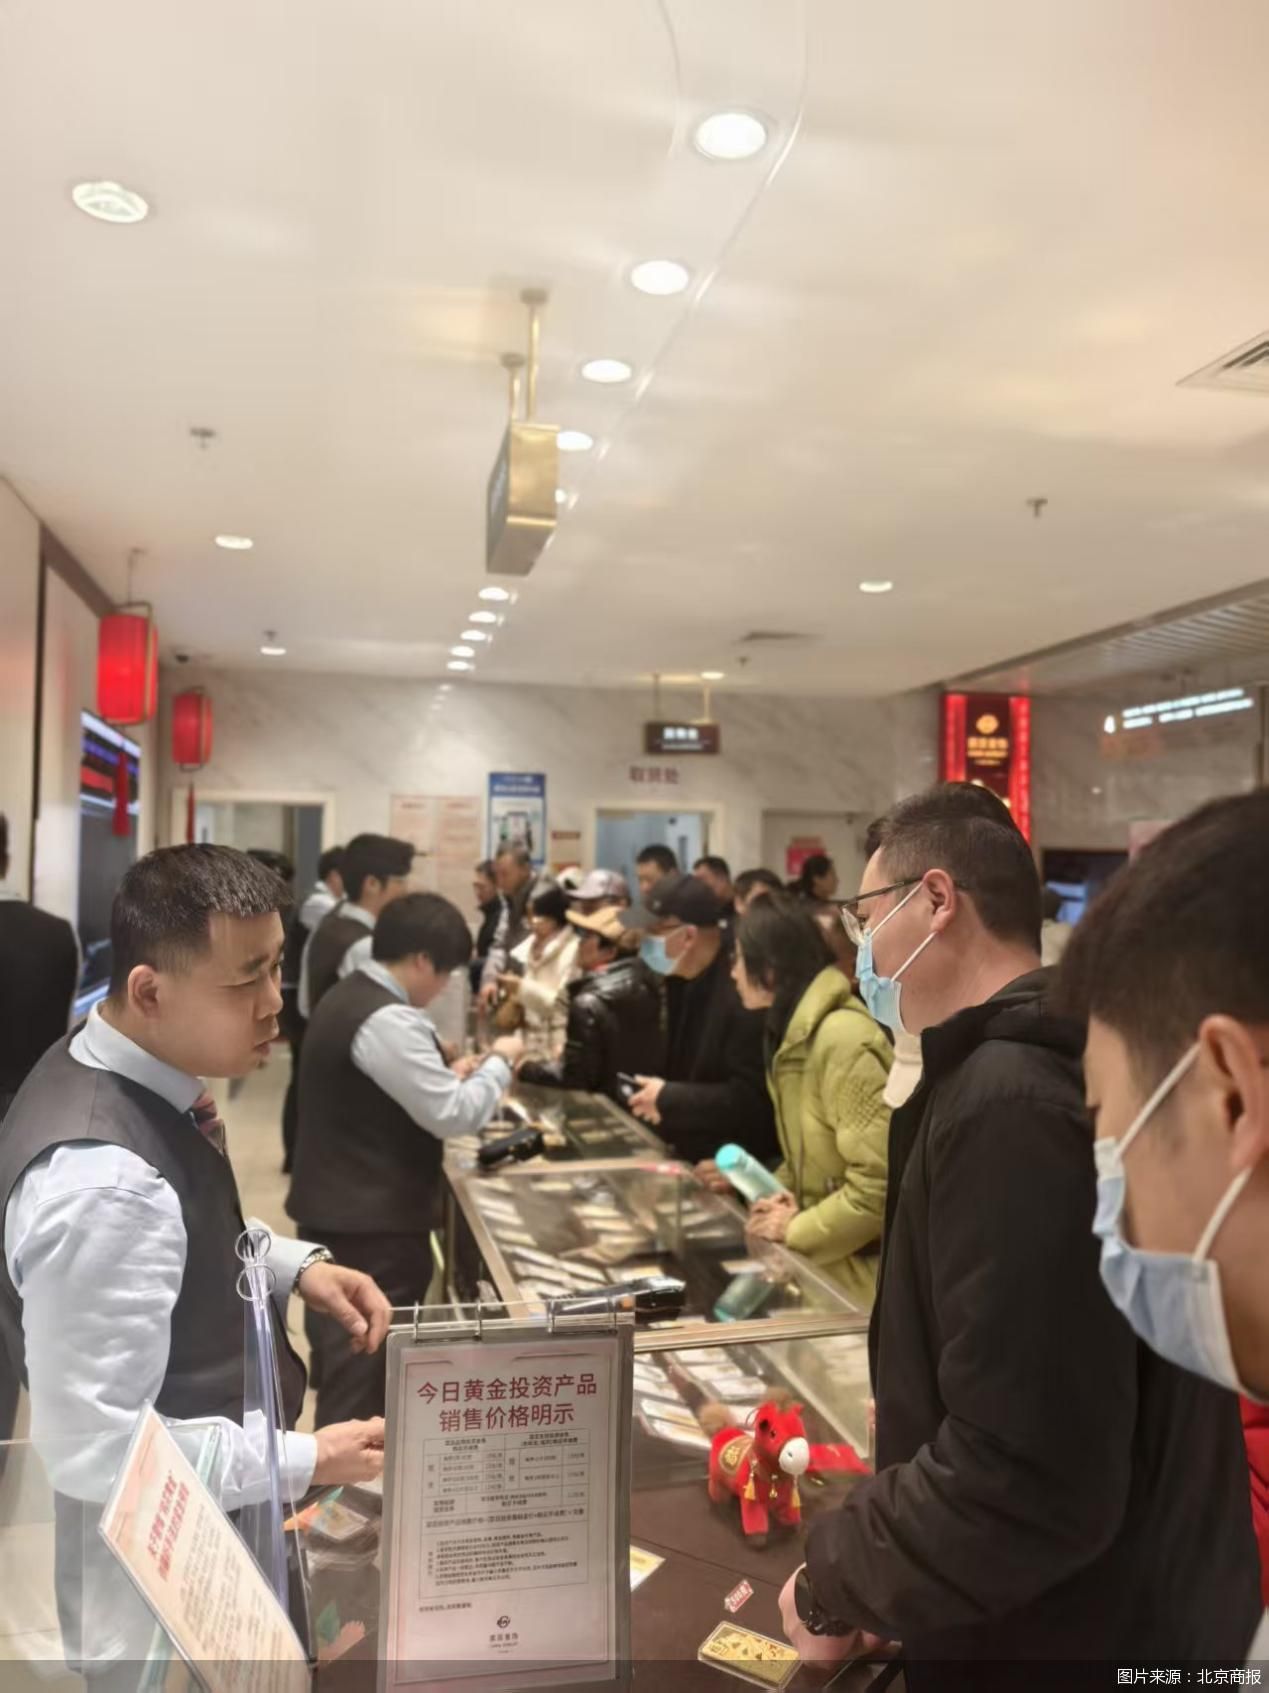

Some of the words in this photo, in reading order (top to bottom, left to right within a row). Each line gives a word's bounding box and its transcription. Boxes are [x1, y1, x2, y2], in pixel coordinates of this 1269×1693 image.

[417, 1373, 597, 1404] 今日黄金投资产品
[439, 1403, 574, 1432] 销售价格明示
